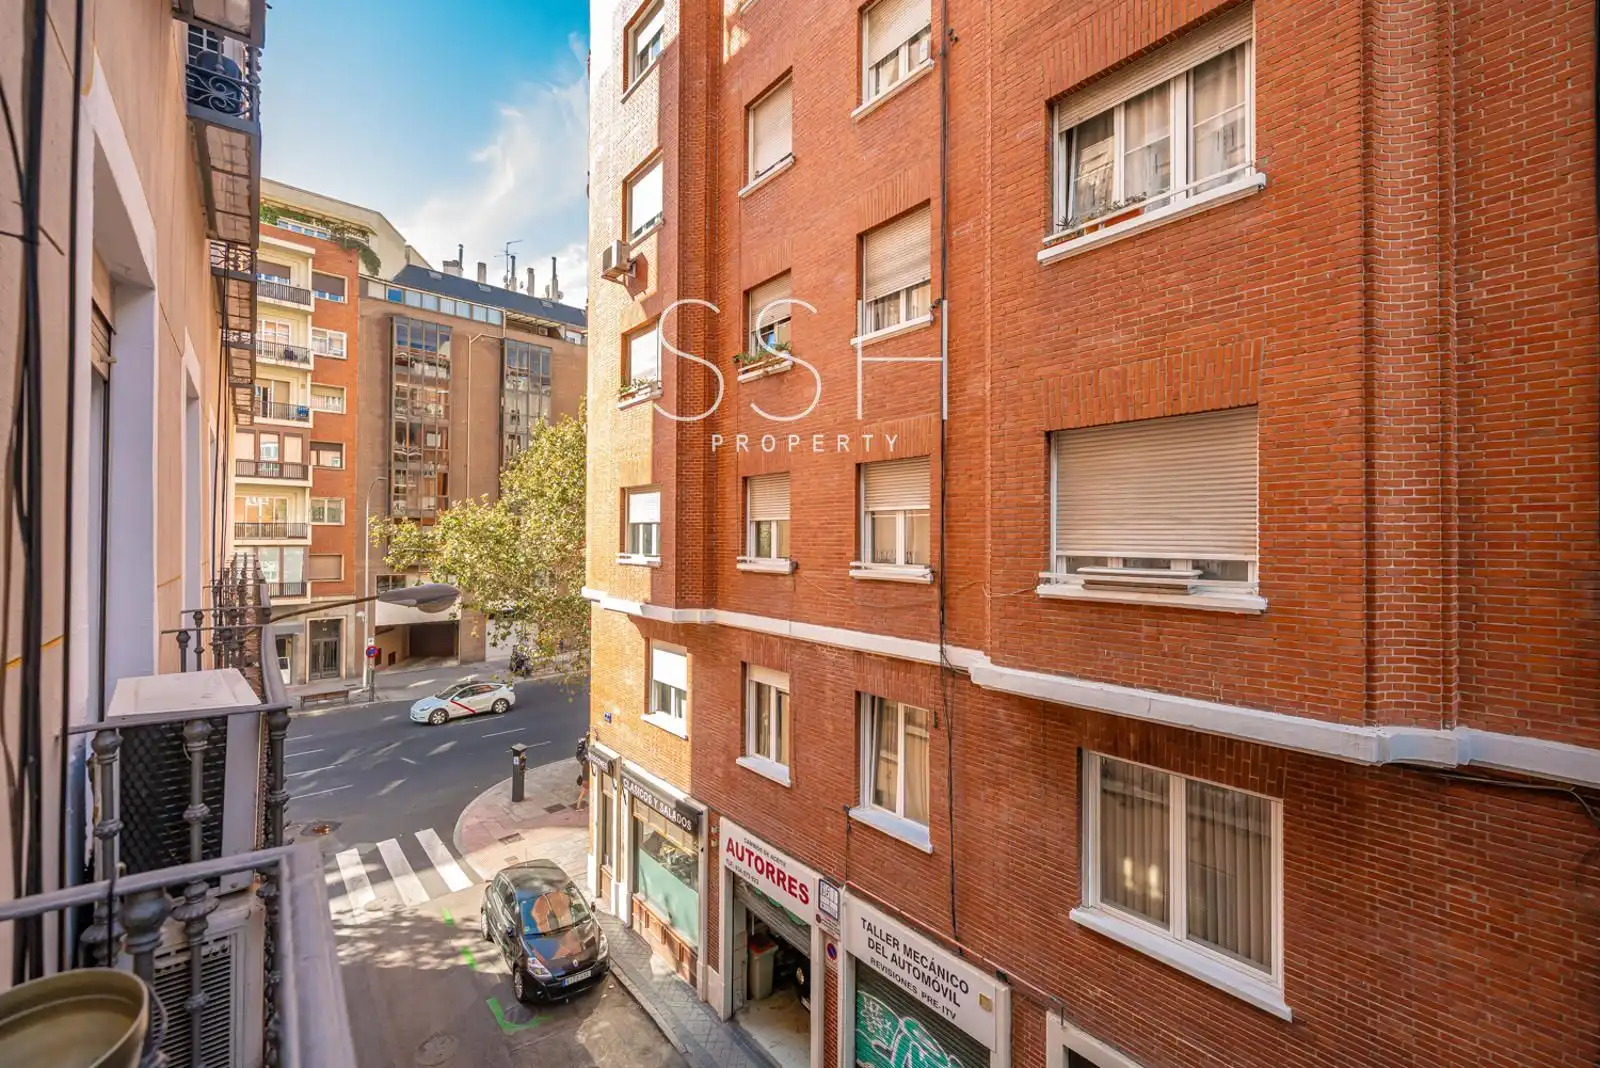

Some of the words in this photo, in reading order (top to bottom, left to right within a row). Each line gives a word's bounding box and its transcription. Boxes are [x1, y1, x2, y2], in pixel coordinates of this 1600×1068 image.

[726, 837, 809, 905] AUTORRES
[861, 917, 900, 952] TALLER
[903, 943, 969, 994] MECÁNICO
[867, 937, 888, 959] DEL
[890, 953, 961, 1008] AUTOMÓVIL
[870, 957, 918, 994] REVISIONES
